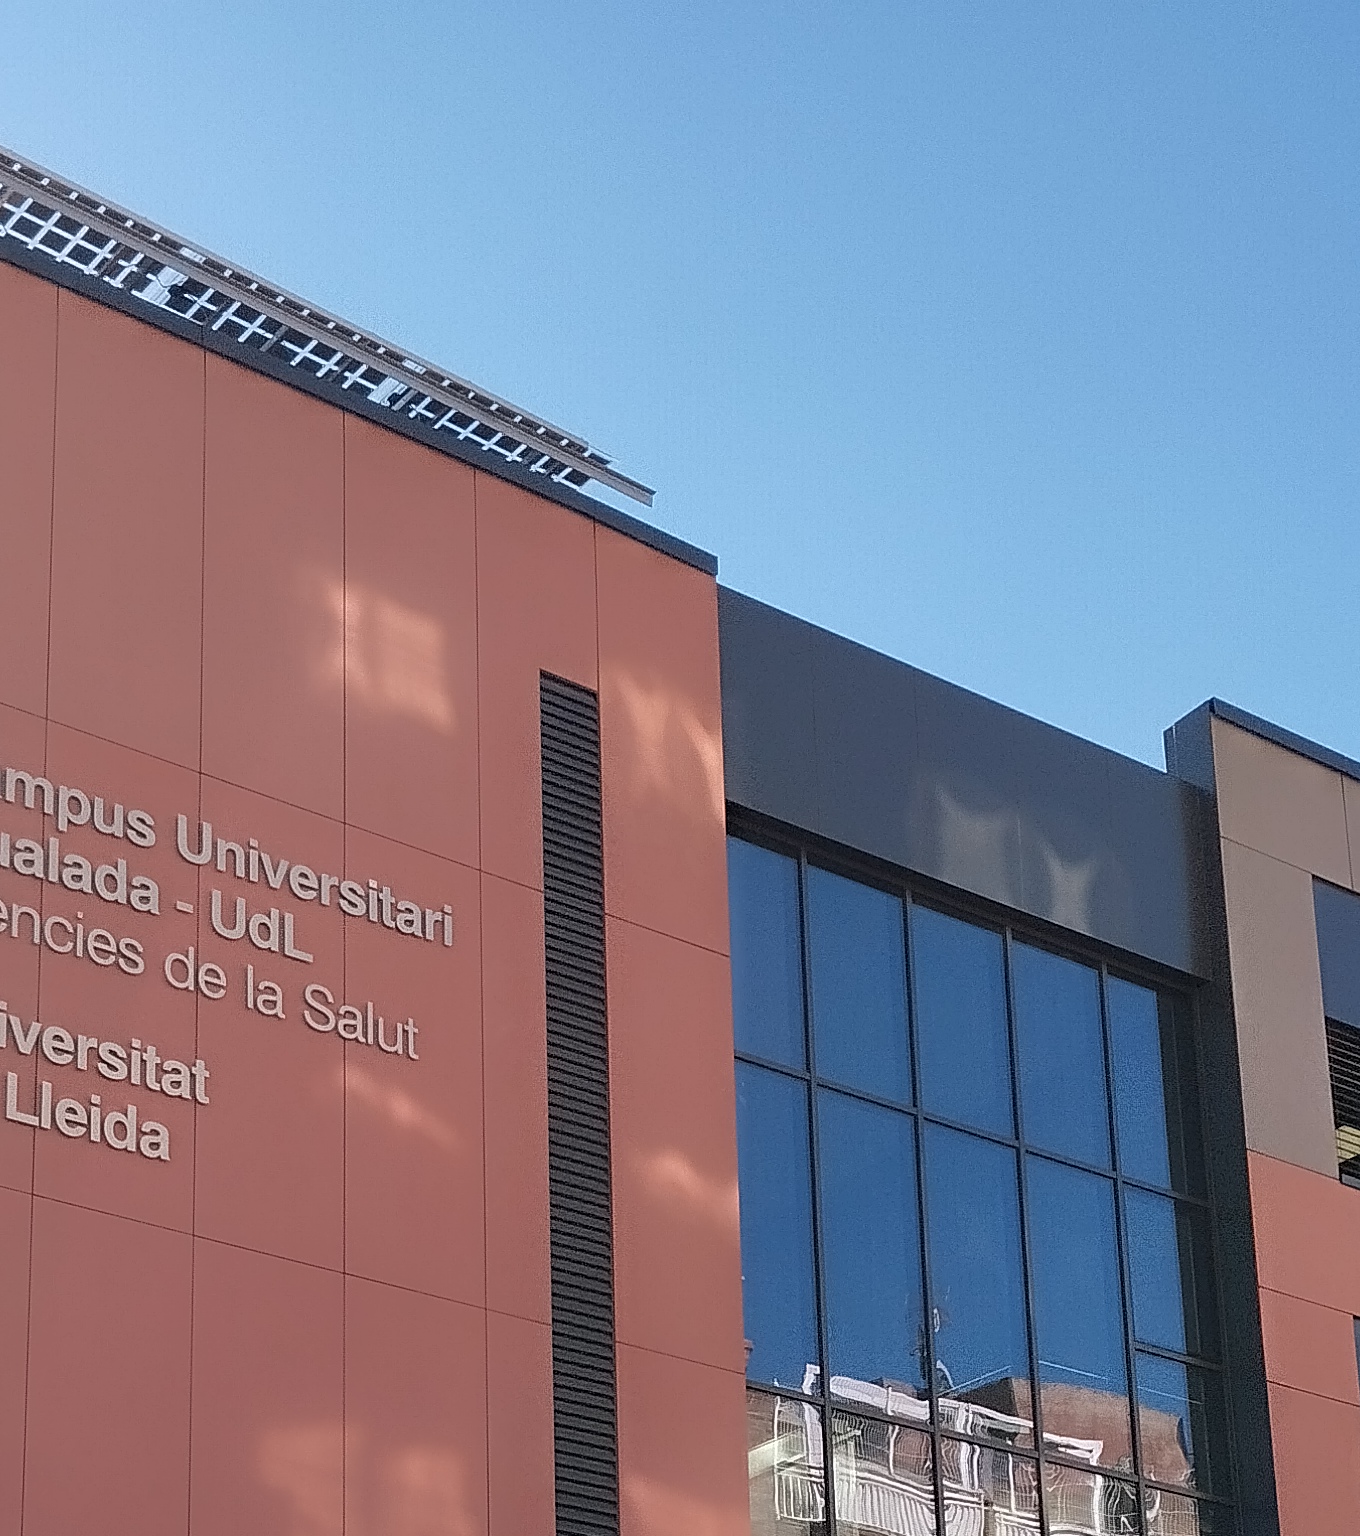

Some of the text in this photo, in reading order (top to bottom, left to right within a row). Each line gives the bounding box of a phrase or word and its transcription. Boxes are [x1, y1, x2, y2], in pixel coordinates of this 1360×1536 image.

[176, 814, 454, 946] Universitari
[210, 889, 314, 963] UdL
[164, 946, 228, 999] de
[246, 964, 285, 1019] la
[303, 984, 420, 1060] Salut
[4, 1072, 171, 1161] Lleida
